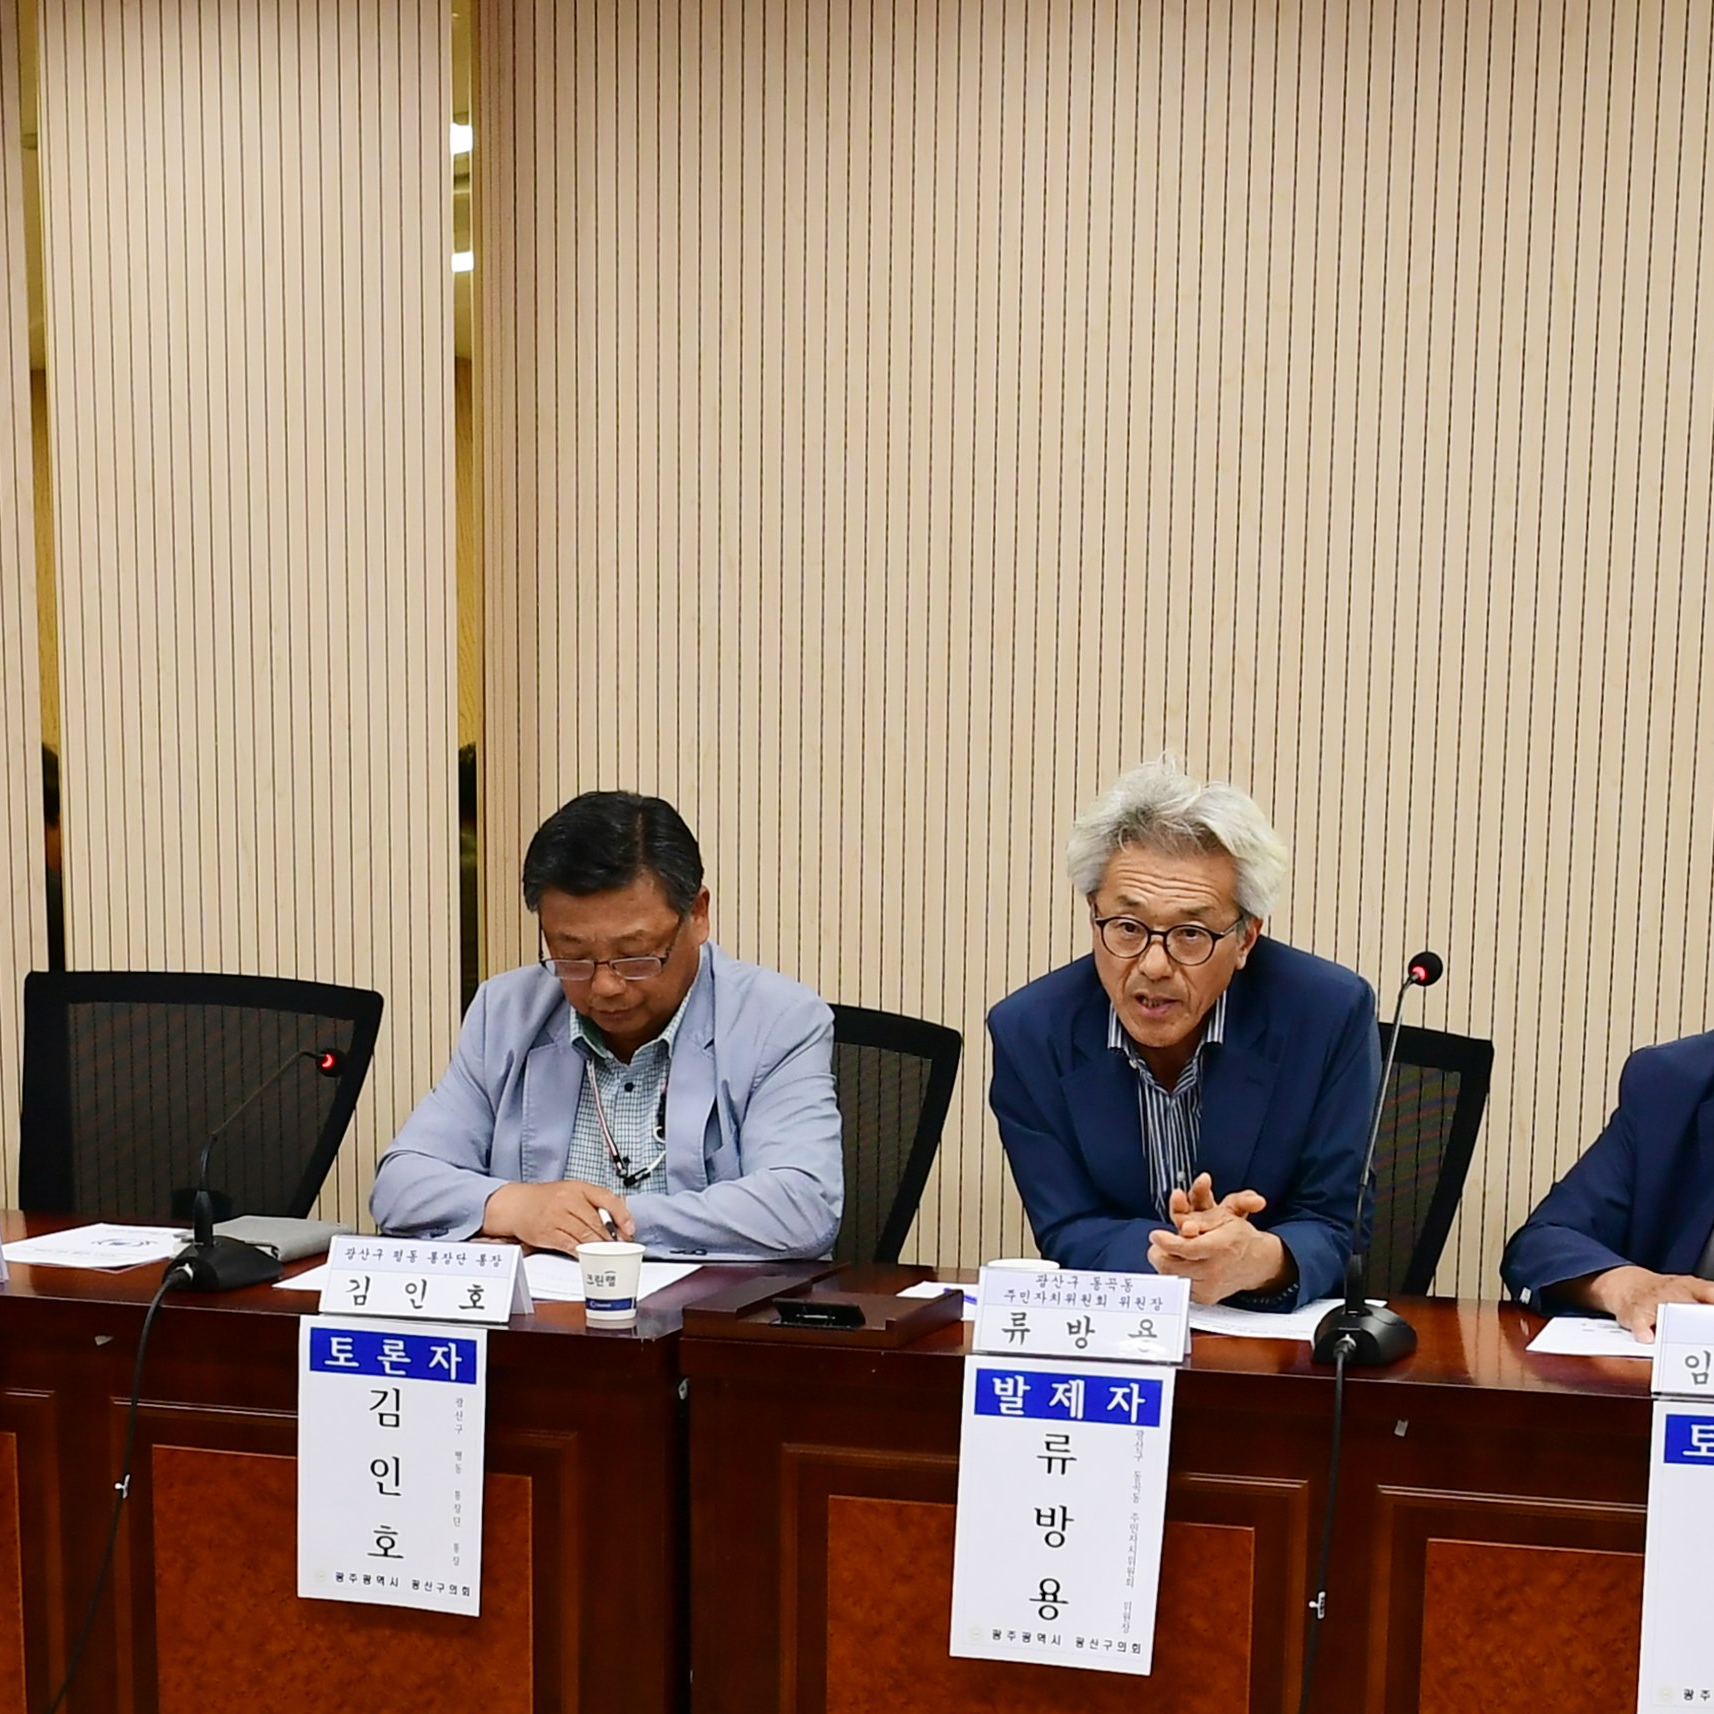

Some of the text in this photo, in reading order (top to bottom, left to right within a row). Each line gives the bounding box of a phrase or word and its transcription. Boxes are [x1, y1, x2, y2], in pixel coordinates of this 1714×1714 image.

[344, 1247, 384, 1262] 광산구
[427, 1250, 467, 1266] 통장단
[476, 1253, 503, 1268] 통장
[345, 1275, 485, 1310] 김인호
[1035, 1274, 1133, 1293] 광산구 동곡동
[1003, 1289, 1164, 1312] 주민자치위원회 위원장
[324, 1337, 463, 1381] 토론자
[992, 1374, 1146, 1424] 발제자
[367, 1387, 404, 1559] 김인호
[1029, 1433, 1078, 1621] 류방용
[335, 1572, 470, 1597] 광주광역시 광산구의회
[992, 1628, 1141, 1654] 광주광역시 광산구의회
